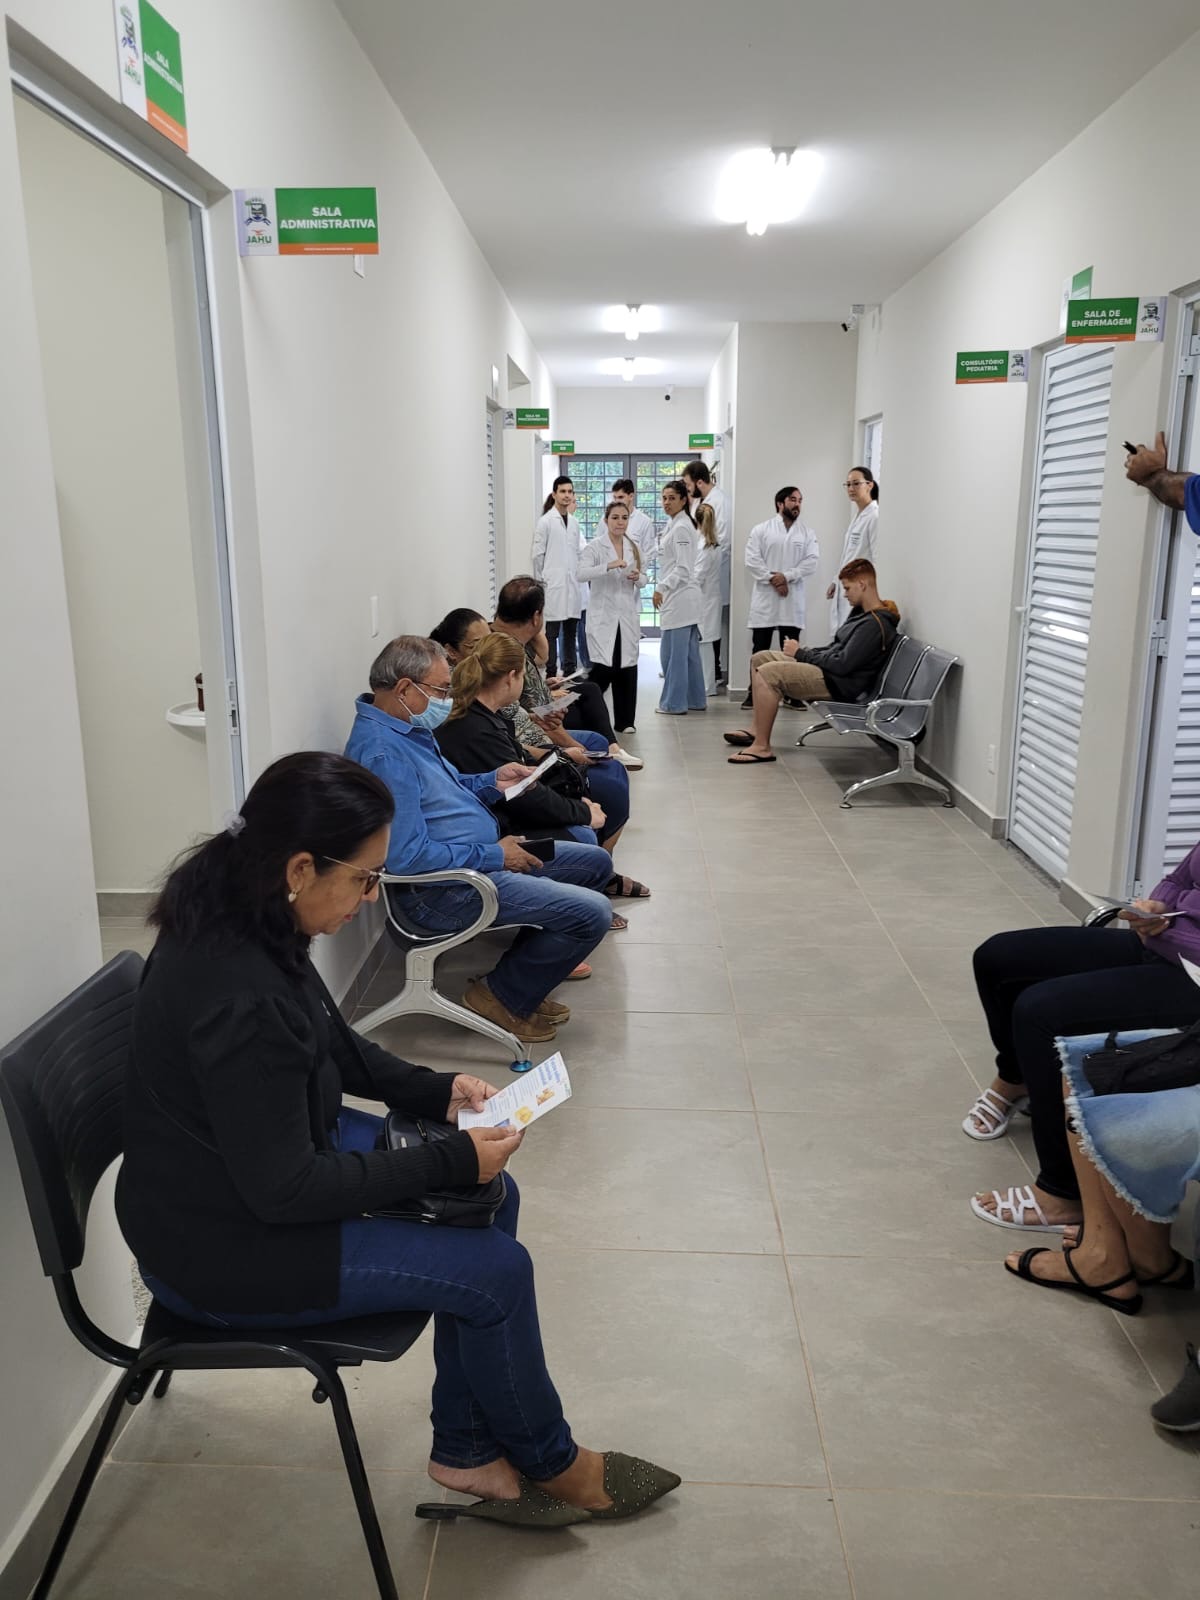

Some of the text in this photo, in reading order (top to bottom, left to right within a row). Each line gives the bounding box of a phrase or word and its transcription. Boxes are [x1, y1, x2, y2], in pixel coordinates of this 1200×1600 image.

[312, 207, 342, 217] SALA
[280, 219, 376, 229] ADMINISTRATIVA
[246, 235, 272, 244] JAHU
[1084, 309, 1121, 318] SALA DE
[1071, 318, 1132, 327] ENFERMAGEM
[960, 358, 1004, 366] CONSULTÓRIO
